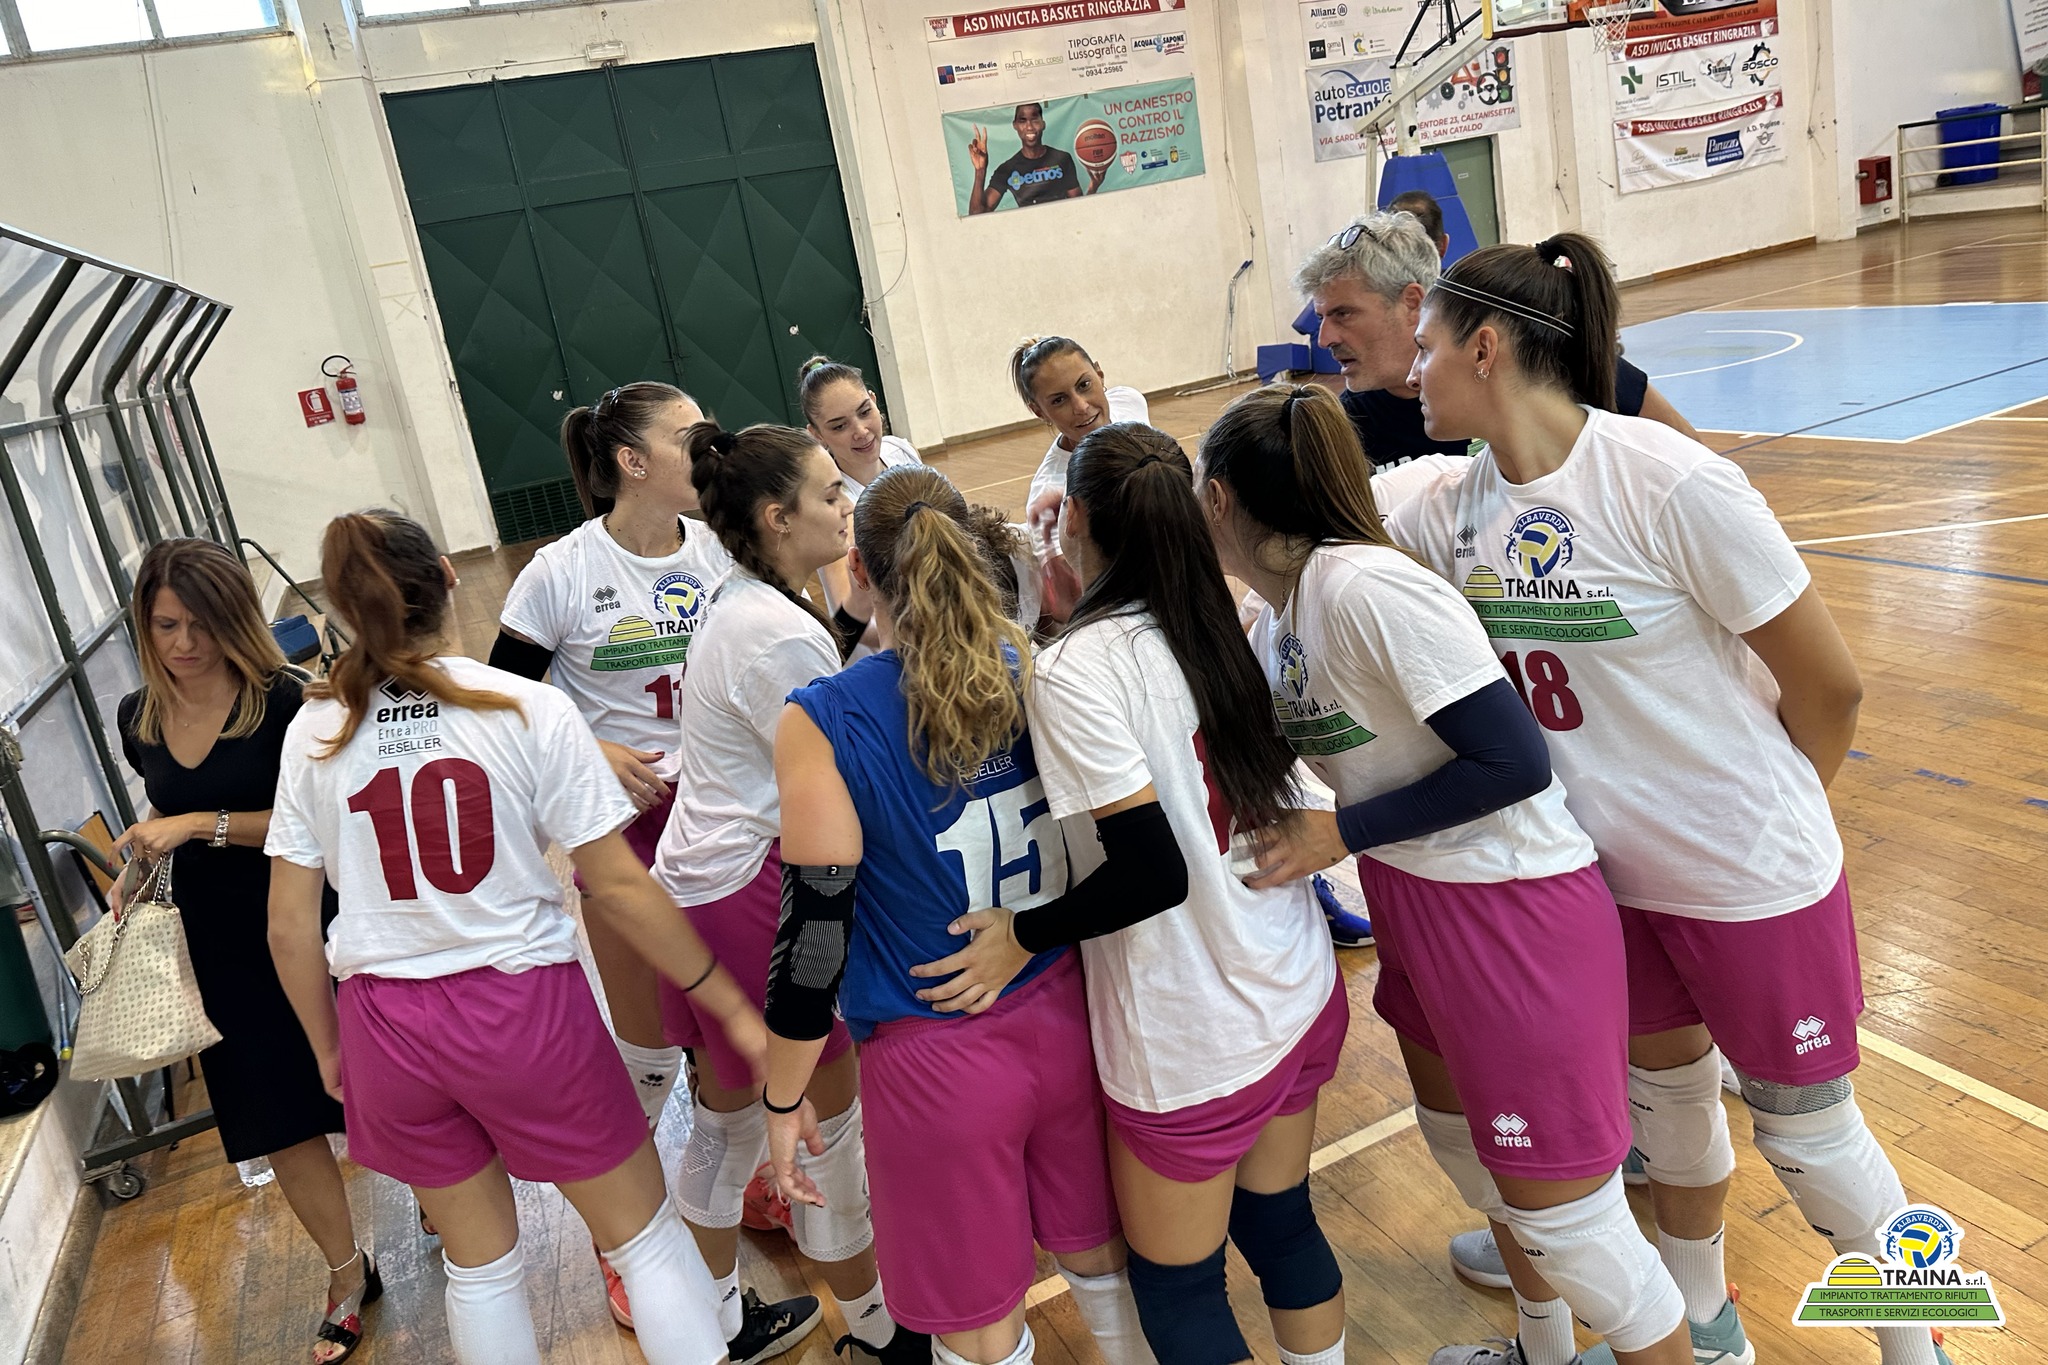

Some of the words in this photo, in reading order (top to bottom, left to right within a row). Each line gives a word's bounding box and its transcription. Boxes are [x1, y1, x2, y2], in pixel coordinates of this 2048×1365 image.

[963, 16, 988, 33] ASD
[990, 9, 1039, 29] INVICTA
[1041, 3, 1085, 23] BASKET
[1087, 0, 1151, 17] RINGRAZIA
[1310, 7, 1336, 18] Allianz
[1068, 33, 1125, 49] TIPOGRAFIA
[1134, 38, 1153, 48] ACQUA
[1162, 34, 1184, 44] SAPONE
[1631, 44, 1649, 57] ASD
[1649, 39, 1682, 54] INVICTA
[1682, 33, 1712, 47] BASKET
[1713, 25, 1756, 42] RINGRAZIA
[1068, 43, 1127, 60] Lussografica
[955, 64, 976, 73] Master
[978, 61, 998, 70] Media
[1005, 60, 1034, 70] FARMACIA
[1086, 65, 1123, 77] 0934.25965
[1741, 57, 1778, 72] BOSCO
[1103, 102, 1122, 116] UN
[1124, 90, 1193, 113] CANESTRO
[1118, 110, 1171, 129] CONTRO
[1172, 109, 1184, 120] IL
[1417, 117, 1448, 129] ENTORE
[1449, 116, 1459, 124] 23,
[1461, 106, 1516, 123] CALTANISSETTA
[1120, 123, 1185, 145] RAZZISMO
[1320, 137, 1334, 146] VIA
[1335, 133, 1361, 144] SARDE
[1421, 131, 1430, 140] 19,
[1433, 129, 1448, 138] SAN
[1450, 123, 1483, 136] CATALDO
[1516, 511, 1566, 532] ALBAVERDE
[659, 574, 698, 590] ALBAVERDE
[1505, 578, 1582, 600] TRAINA
[1586, 586, 1614, 598] s.r.l.
[1493, 604, 1561, 617] TRATTAMENTO
[1565, 605, 1604, 617] RIFIUTI
[1502, 625, 1508, 634] E
[1509, 624, 1542, 636] SERVIZI
[1544, 626, 1608, 638] ECOLOGICI
[603, 643, 647, 656] IMPIANTO
[649, 637, 690, 650] TRATTAME
[605, 657, 654, 669] TRASPORTI
[655, 656, 660, 664] E
[662, 651, 686, 663] SERVIZ
[1323, 699, 1342, 713] s.r.l.
[378, 737, 442, 756] RESELLER
[347, 757, 496, 901] 10
[935, 775, 1070, 914] 15
